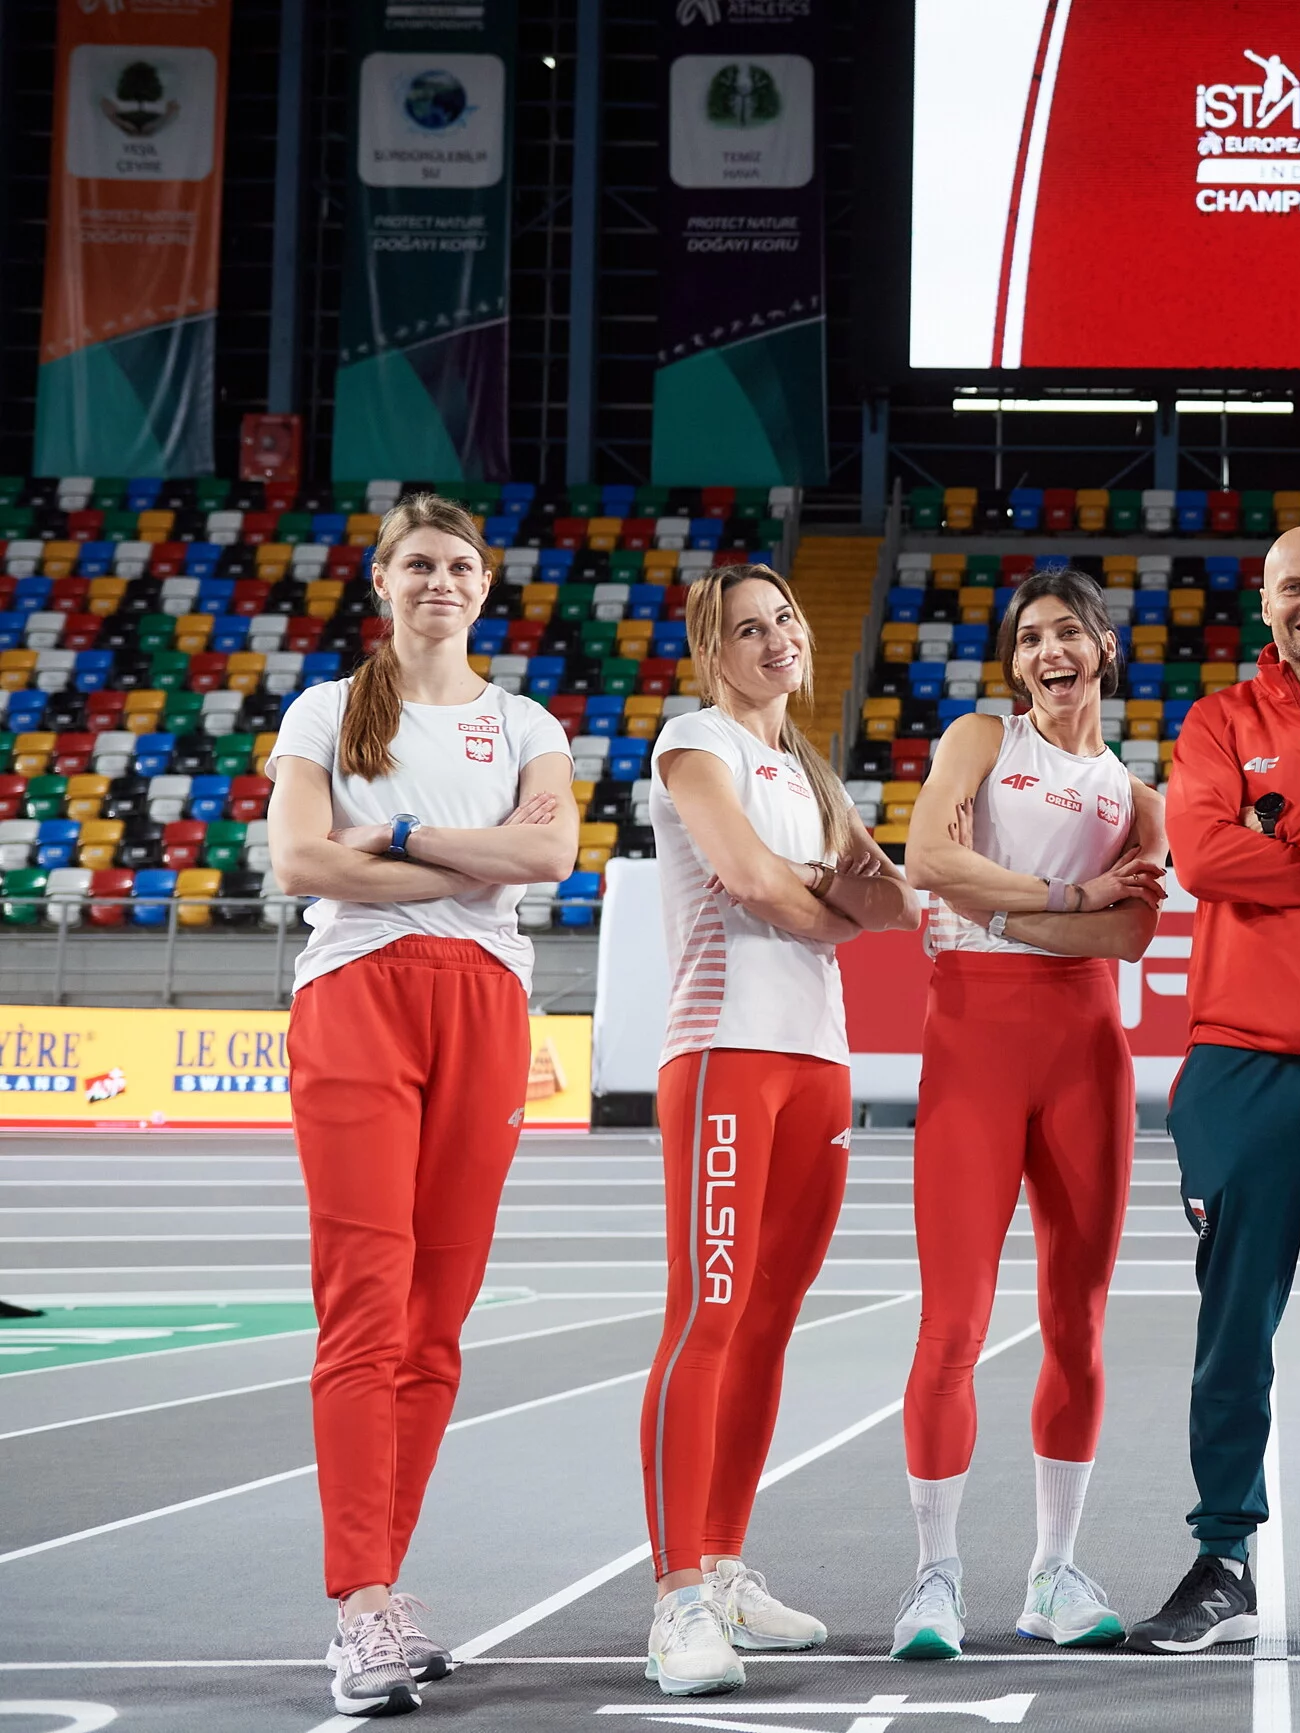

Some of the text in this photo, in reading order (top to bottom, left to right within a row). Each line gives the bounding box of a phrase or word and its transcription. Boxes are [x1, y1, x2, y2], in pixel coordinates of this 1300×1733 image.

[687, 216, 799, 230] PROTECT NATURE
[686, 235, 799, 252] DOĞAYI KORU
[459, 725, 498, 733] ORLEN
[756, 765, 778, 780] 4F
[1243, 756, 1280, 774] 4F
[1001, 773, 1040, 791] 4F
[1048, 796, 1080, 811] ORLEN
[176, 1030, 215, 1067] LE
[705, 1114, 737, 1305] POLSKA
